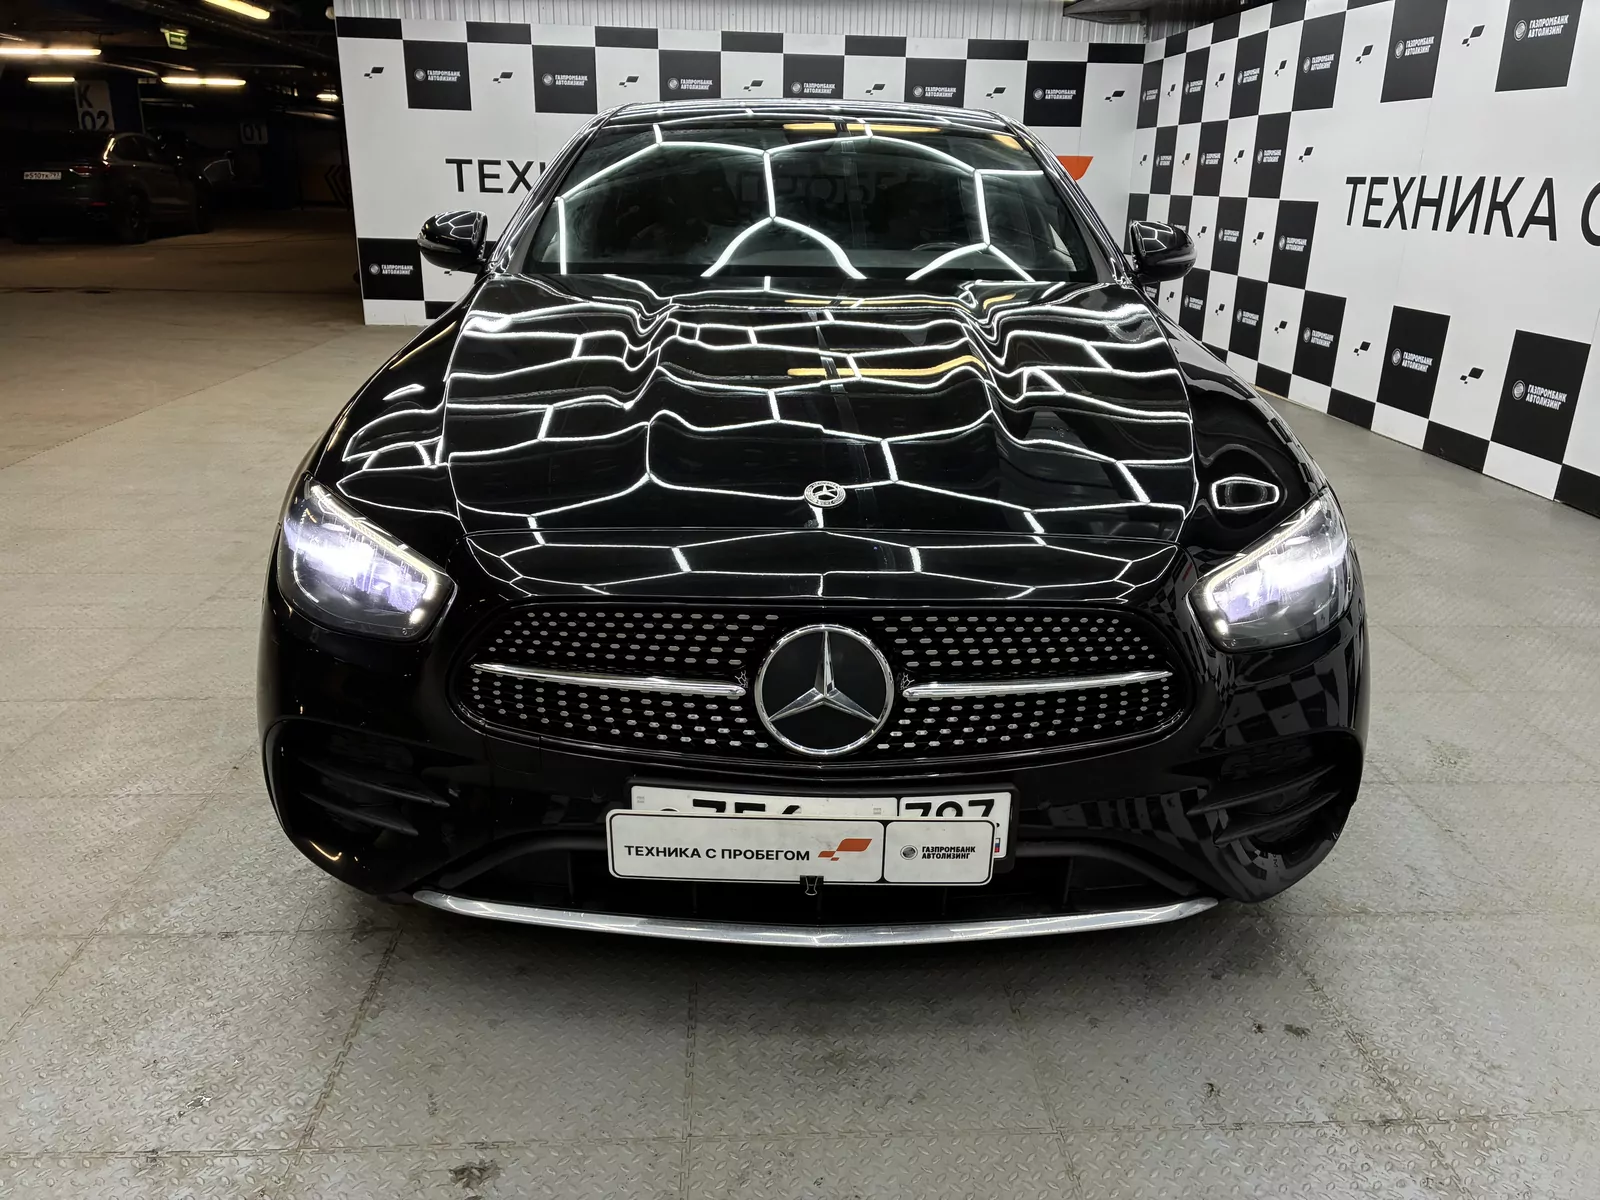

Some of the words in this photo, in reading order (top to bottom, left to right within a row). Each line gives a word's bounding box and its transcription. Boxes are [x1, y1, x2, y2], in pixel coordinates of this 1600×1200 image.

[1529, 14, 1570, 28] ГАЗПРОМБАНК
[1528, 25, 1564, 38] АВТОЛИЗИНГ
[1406, 36, 1435, 48] ГАЗПРОМБАНК
[1346, 175, 1557, 242] ТЕХНИКА
[1402, 359, 1429, 373] АВТОЛИЗИНГ
[1403, 351, 1433, 366] ГАЗПРОМБАНК
[1527, 384, 1568, 402] ГАЗПРОМБАНК
[1525, 393, 1562, 410] АВТОЛИЗИНГ
[624, 845, 701, 859] ТЕХНИКА
[705, 848, 717, 859] С
[722, 849, 810, 861] ПРОБЕГОМ
